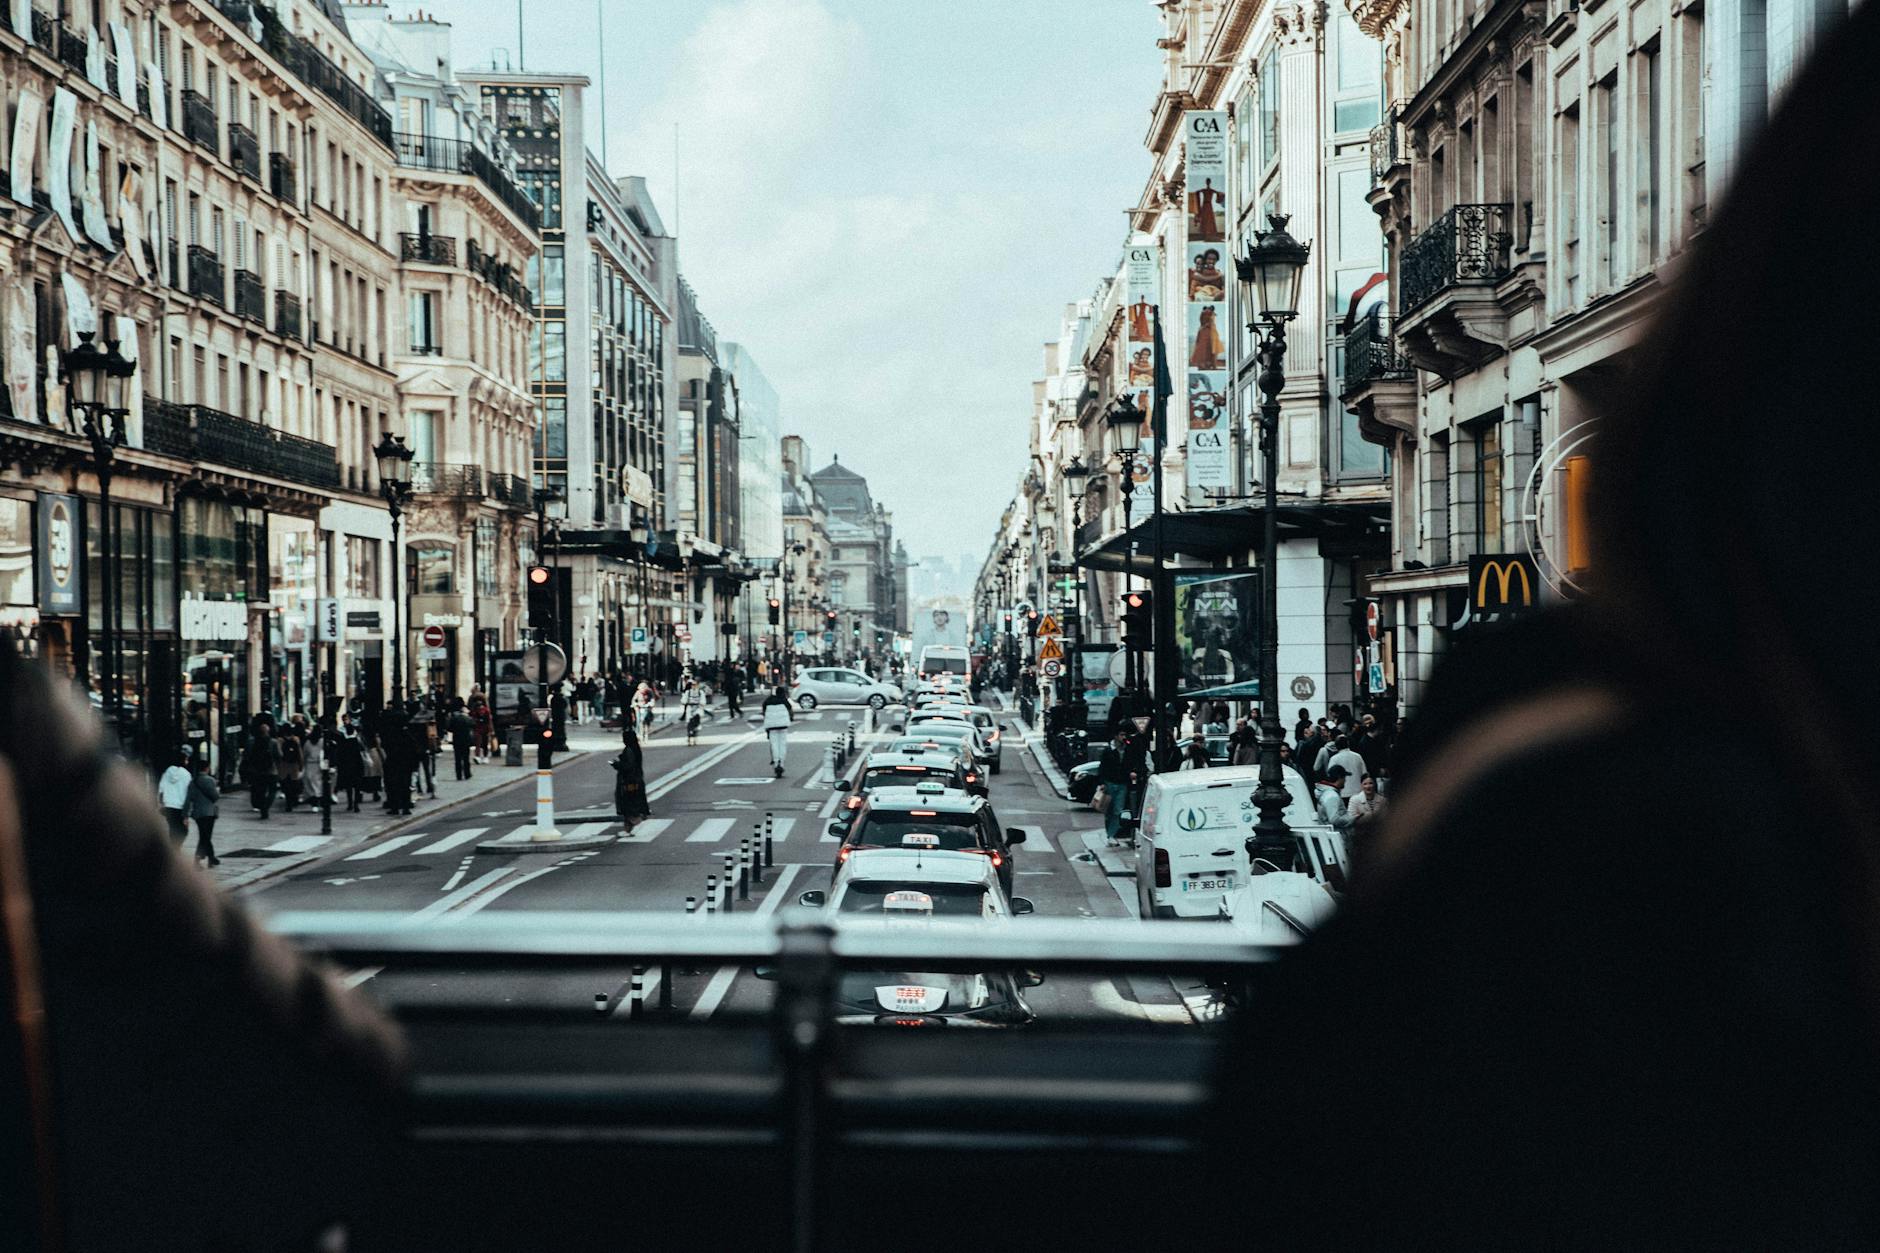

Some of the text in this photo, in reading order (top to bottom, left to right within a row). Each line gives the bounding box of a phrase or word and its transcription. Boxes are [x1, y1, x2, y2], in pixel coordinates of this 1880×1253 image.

[1193, 117, 1220, 133] C&A
[1195, 432, 1221, 447] C&A
[1045, 663, 1059, 673] 30
